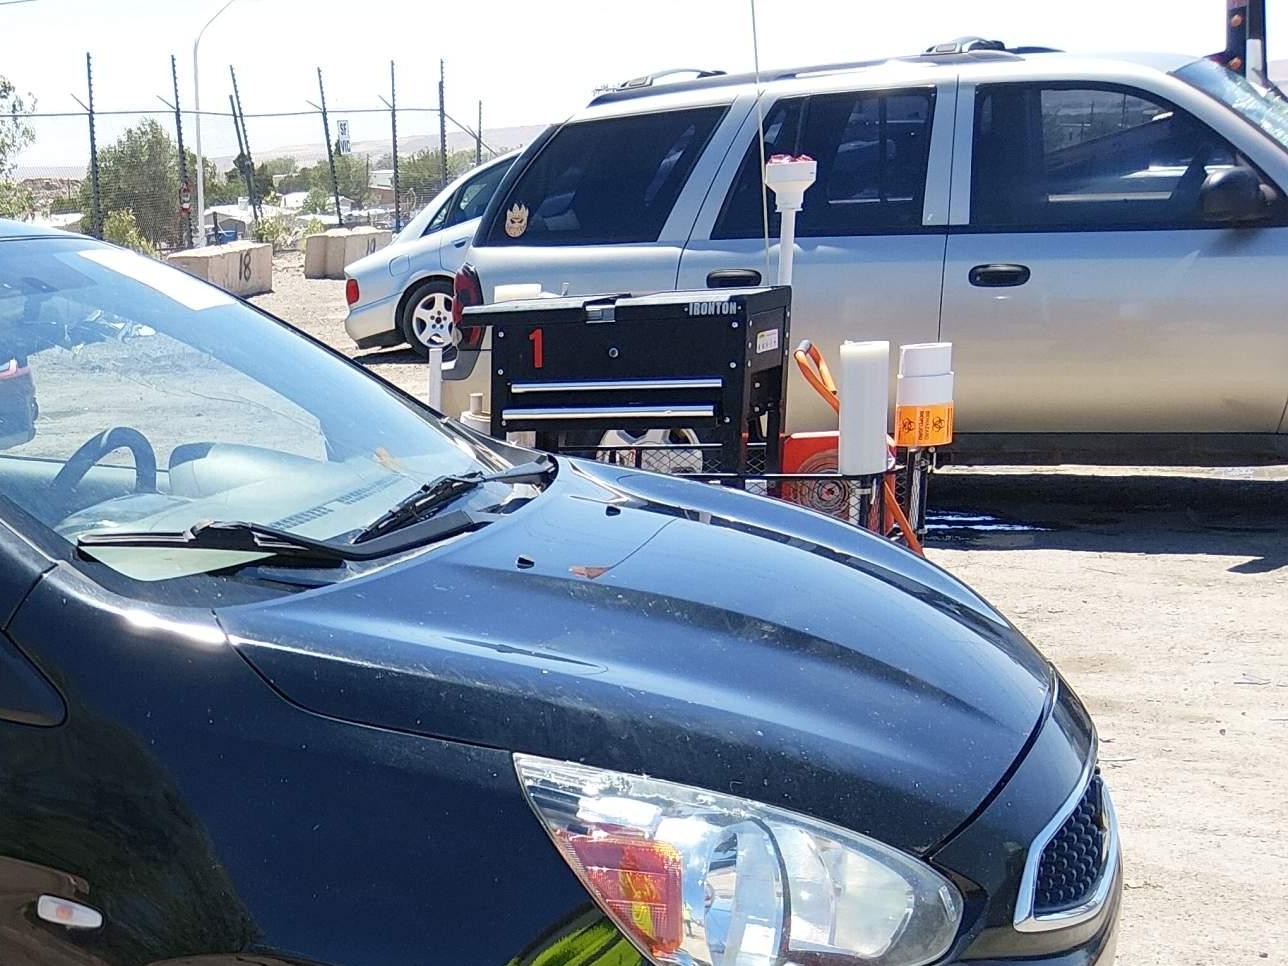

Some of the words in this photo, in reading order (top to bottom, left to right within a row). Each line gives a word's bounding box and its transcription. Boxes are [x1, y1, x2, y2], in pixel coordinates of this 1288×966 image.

[239, 251, 252, 282] 18
[689, 302, 737, 316] IRONTON
[529, 328, 543, 369] 1
